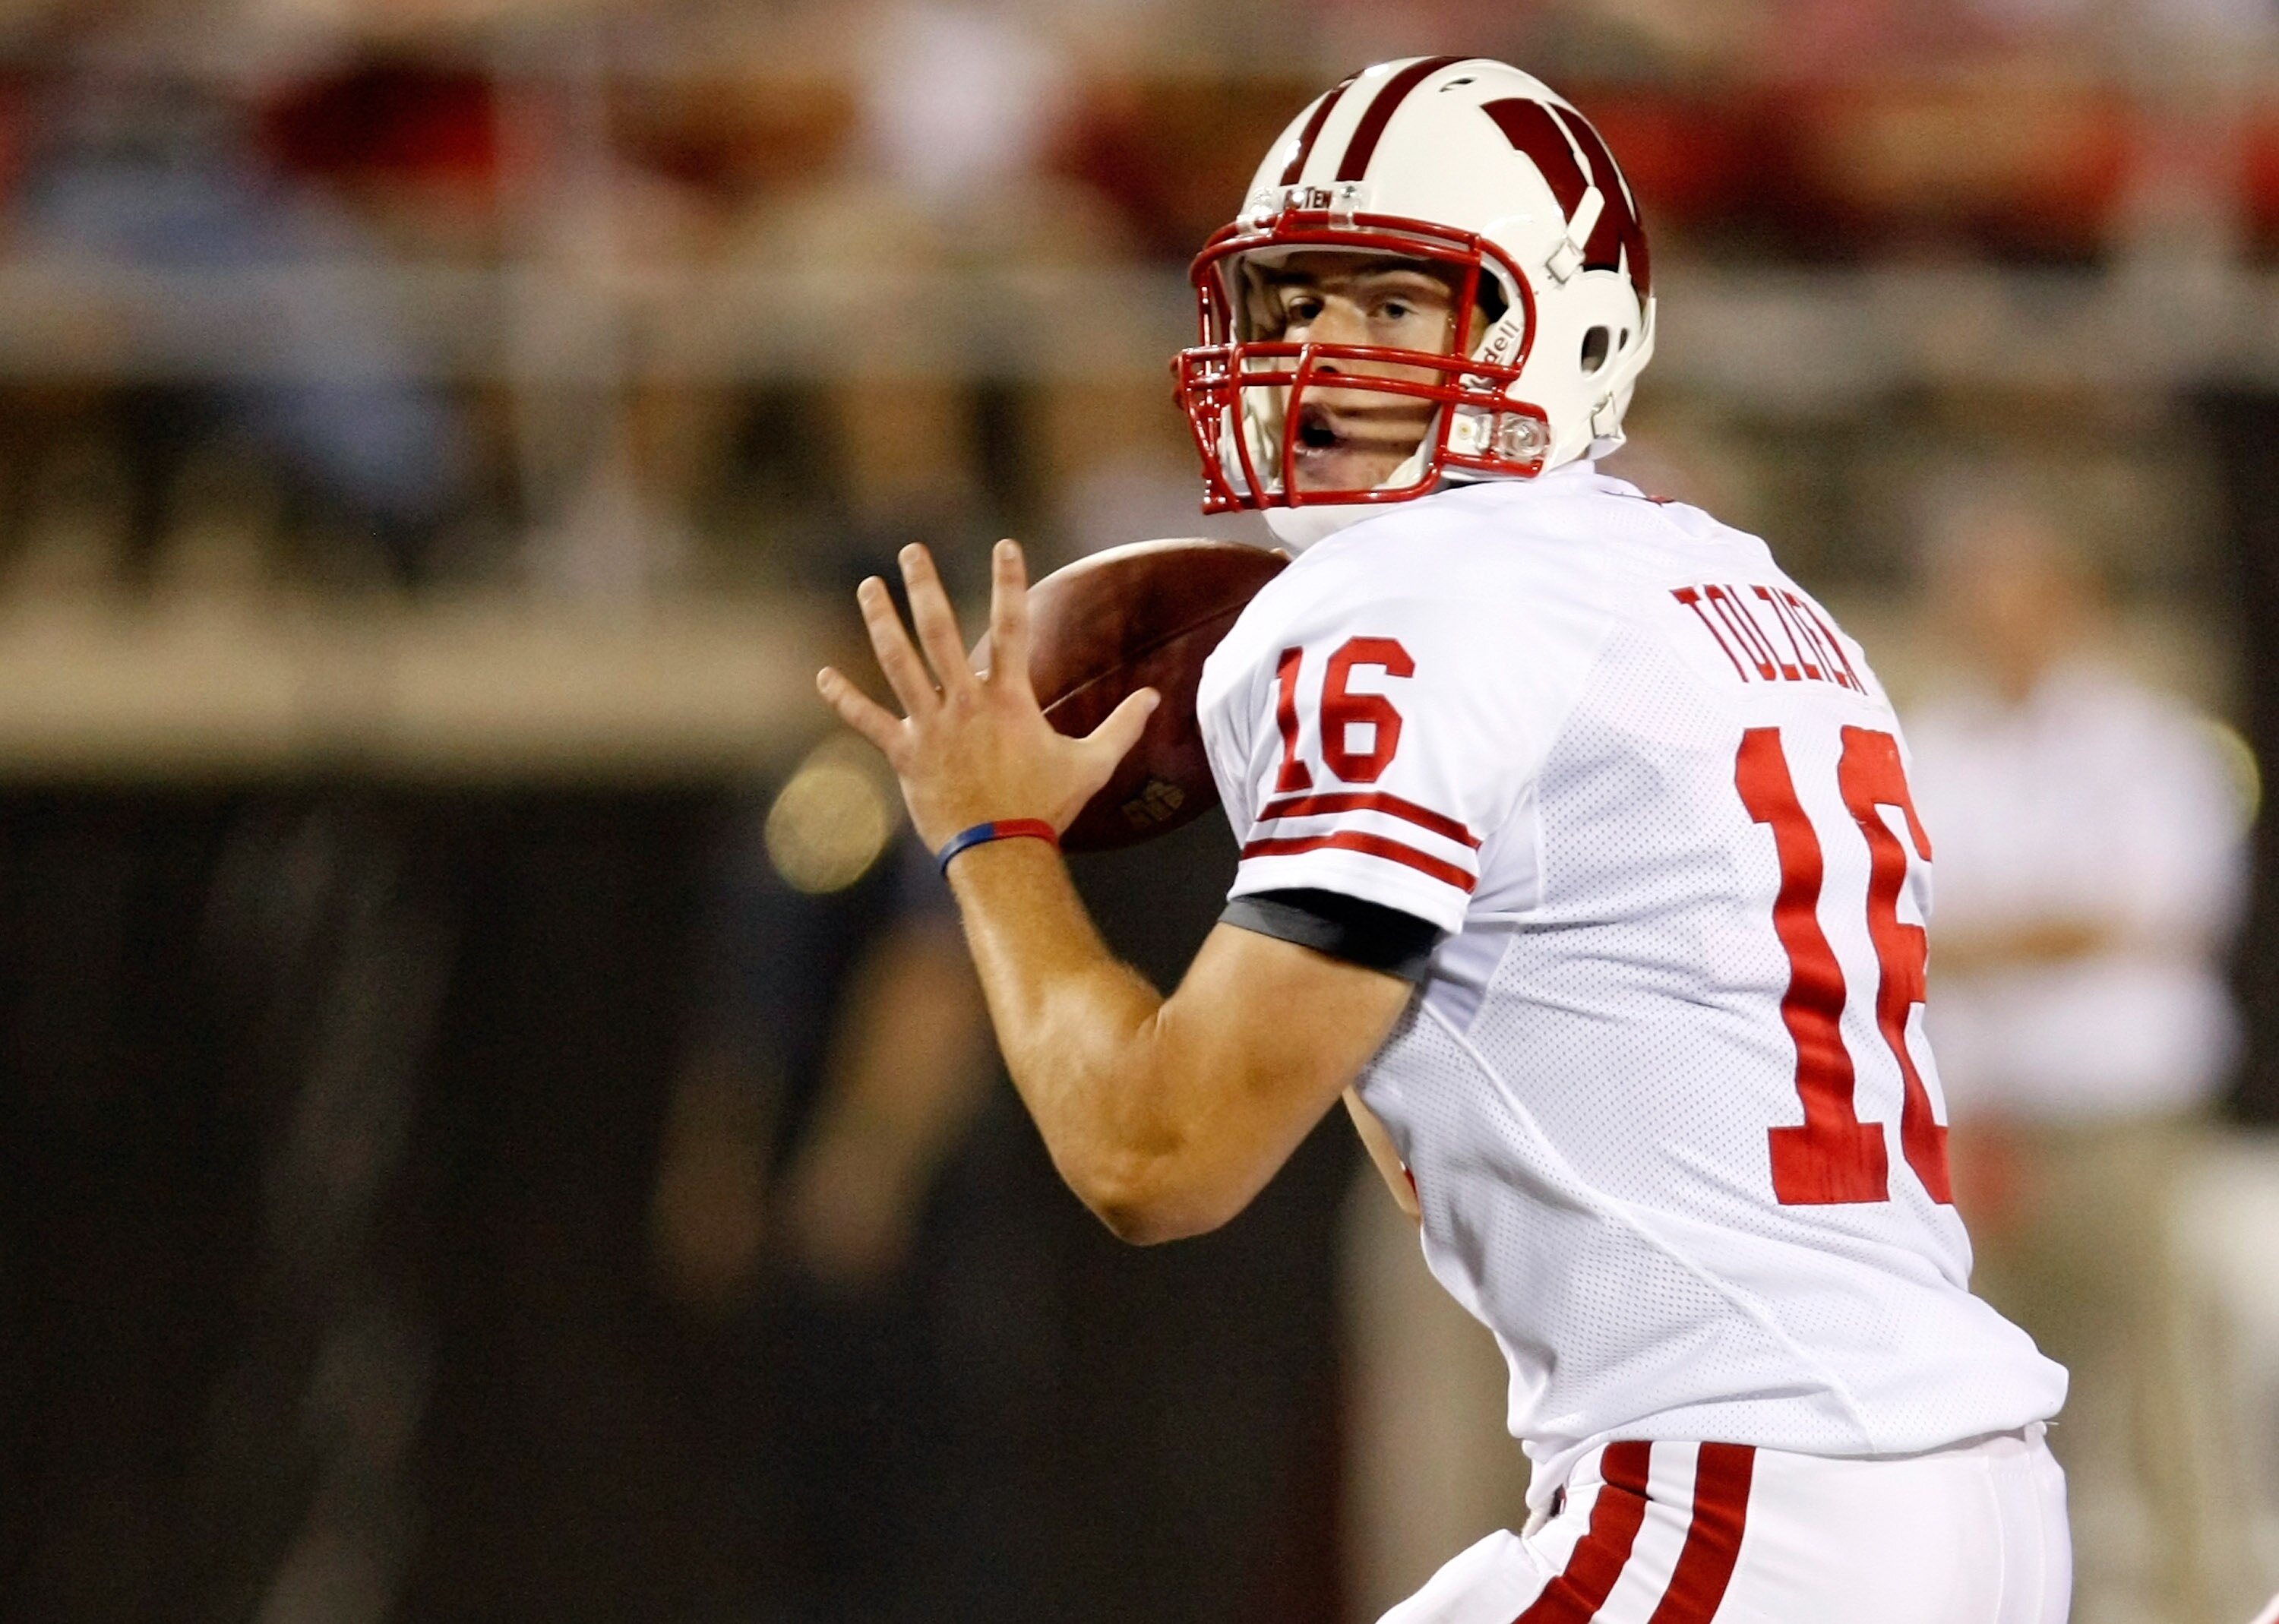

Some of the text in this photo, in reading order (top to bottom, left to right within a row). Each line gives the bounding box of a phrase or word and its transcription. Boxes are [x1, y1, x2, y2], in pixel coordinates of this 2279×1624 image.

[1484, 320, 1520, 365] dell
[1274, 636, 1415, 793] 16
[1734, 725, 1954, 1204] 16
